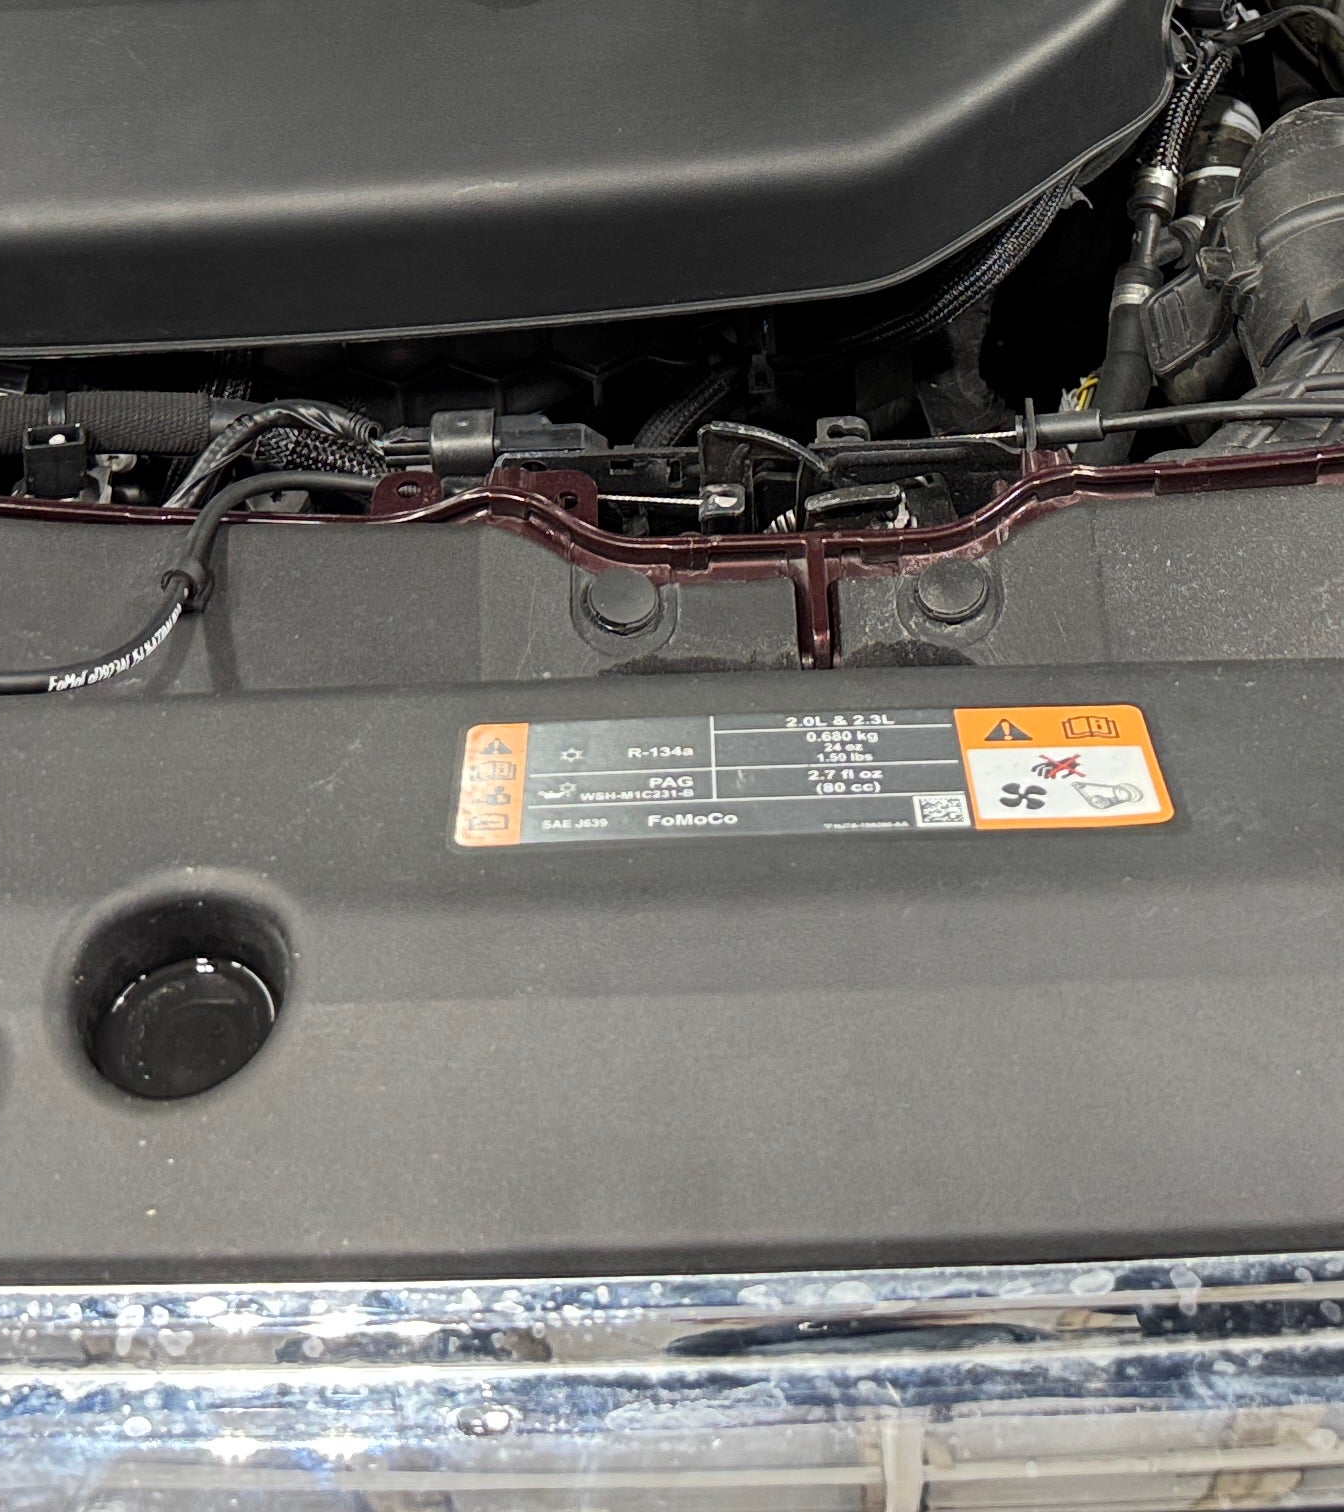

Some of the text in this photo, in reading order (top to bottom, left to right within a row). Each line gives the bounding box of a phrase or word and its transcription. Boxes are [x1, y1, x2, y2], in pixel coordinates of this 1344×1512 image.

[785, 713, 896, 728] 2.0L & 2.3L
[805, 729, 879, 744] 0.680 kg
[627, 746, 694, 759] R-134a
[823, 743, 864, 753] 24 oz
[816, 751, 874, 763] 1.50 lbs
[807, 768, 884, 781] 2.7 fl oz
[648, 775, 694, 789] PAG
[815, 780, 882, 795] (80 cc)
[579, 788, 695, 802] WSH-M1C231-B
[541, 817, 609, 830] SAE J639
[647, 811, 739, 828] FoMoCo
